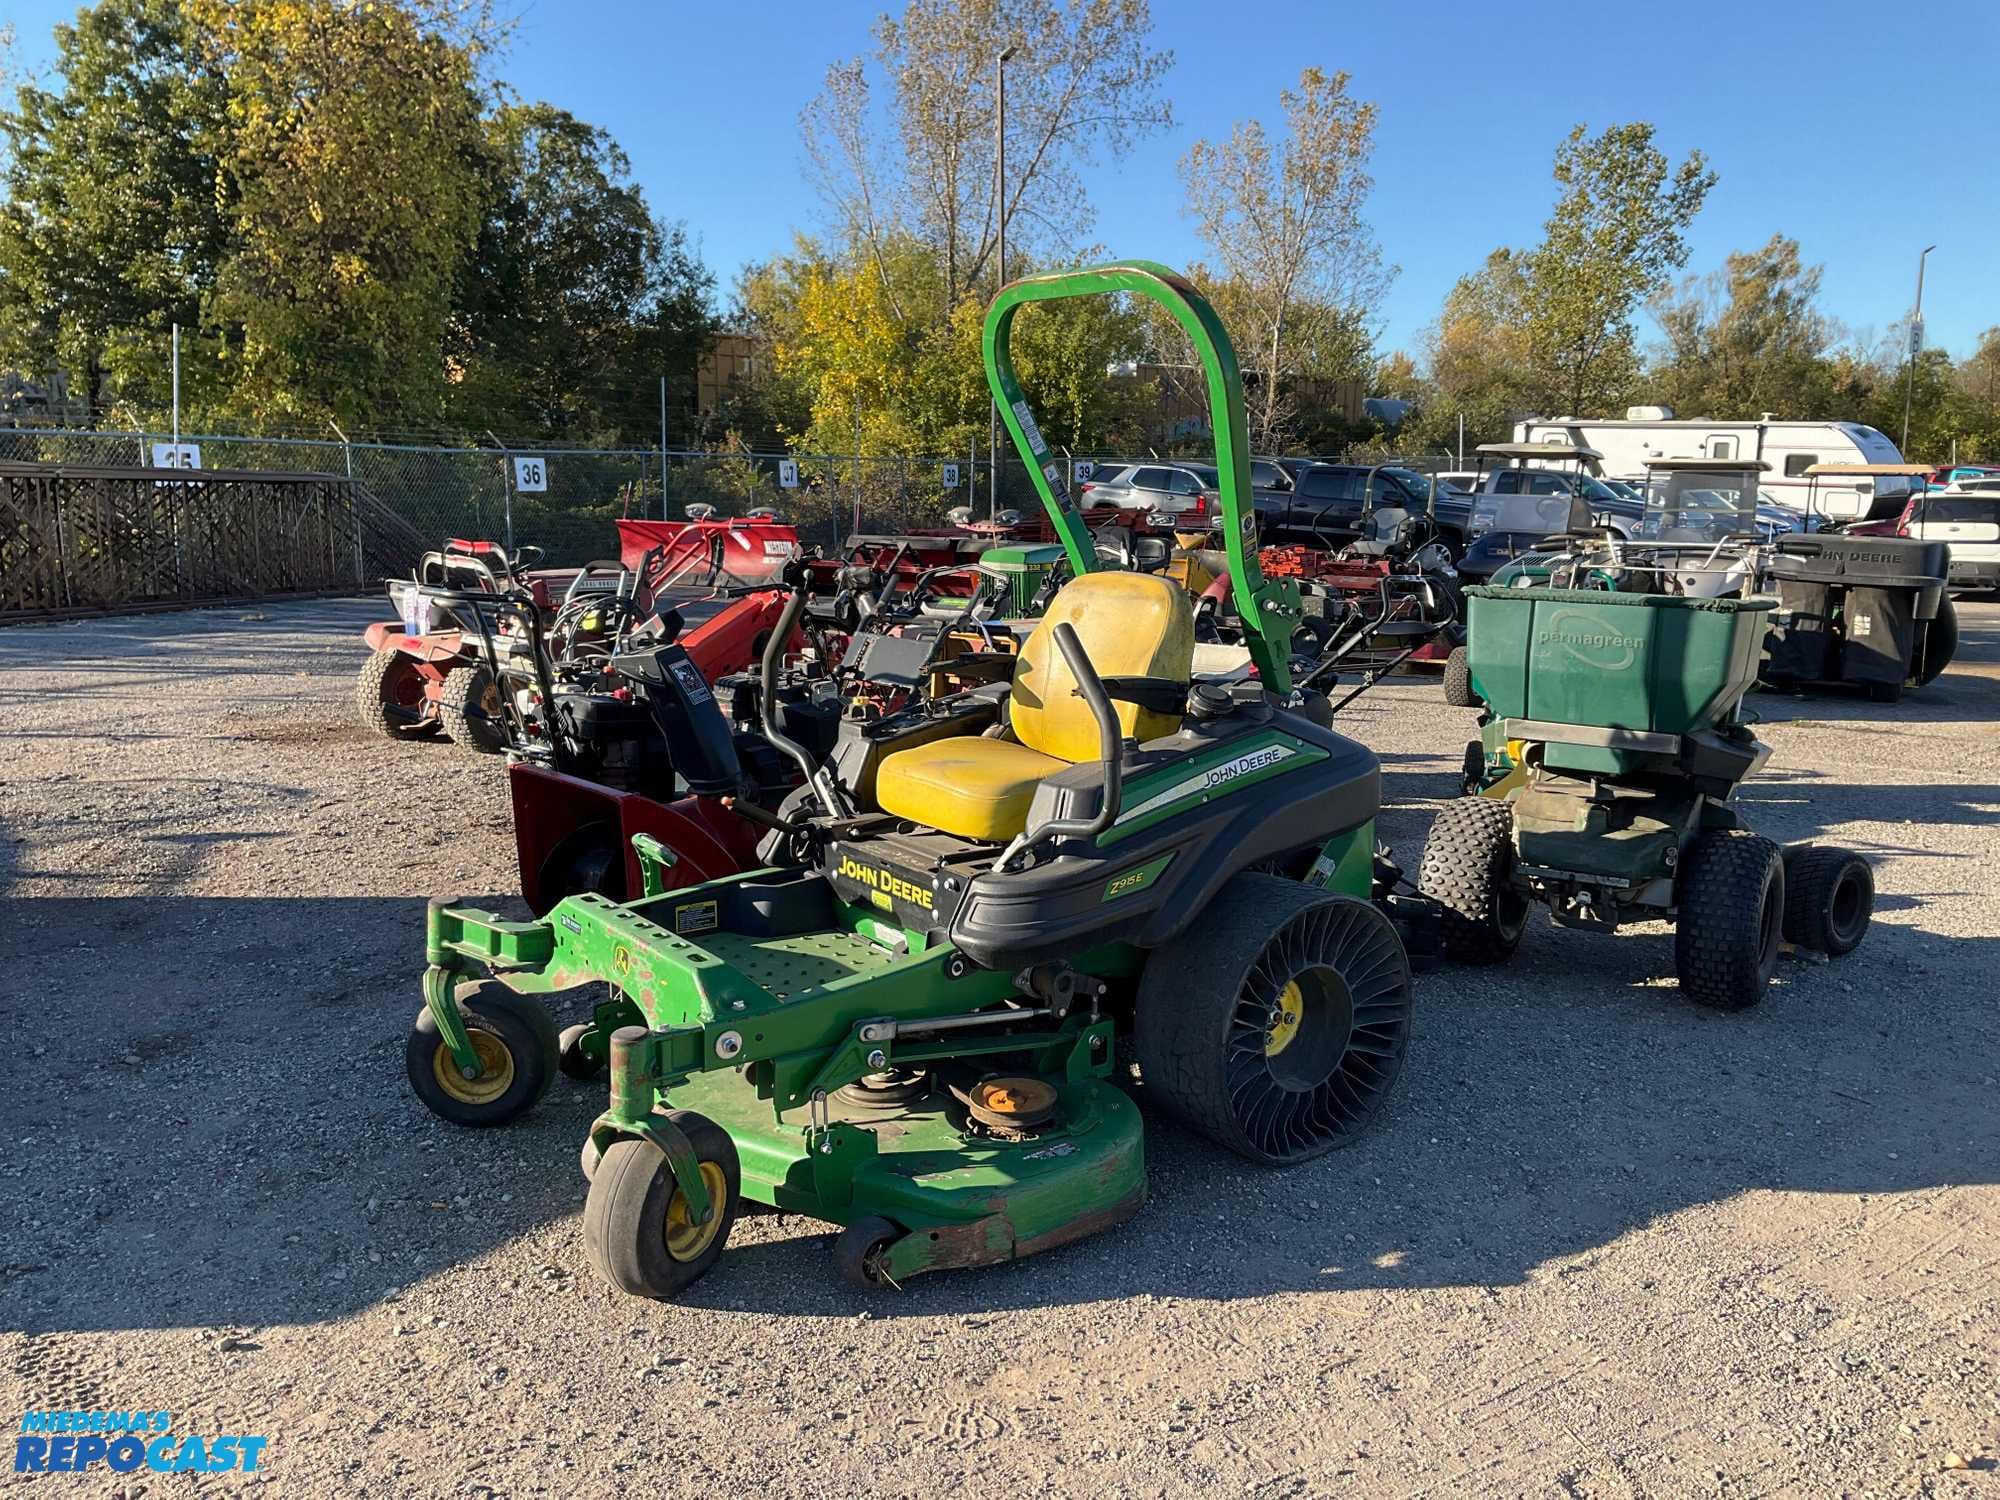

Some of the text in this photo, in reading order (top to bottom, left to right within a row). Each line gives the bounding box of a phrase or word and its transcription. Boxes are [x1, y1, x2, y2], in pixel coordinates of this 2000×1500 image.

[522, 464, 541, 485] 36
[784, 465, 794, 482] 37
[1079, 466, 1090, 479] 39
[1849, 552, 1901, 563] DEERE
[1540, 630, 1647, 649] permagreen
[1204, 749, 1280, 787] JOHN DEERE
[839, 855, 877, 887] JOHN
[880, 869, 933, 910] DEERE
[1110, 872, 1144, 895] Z915E
